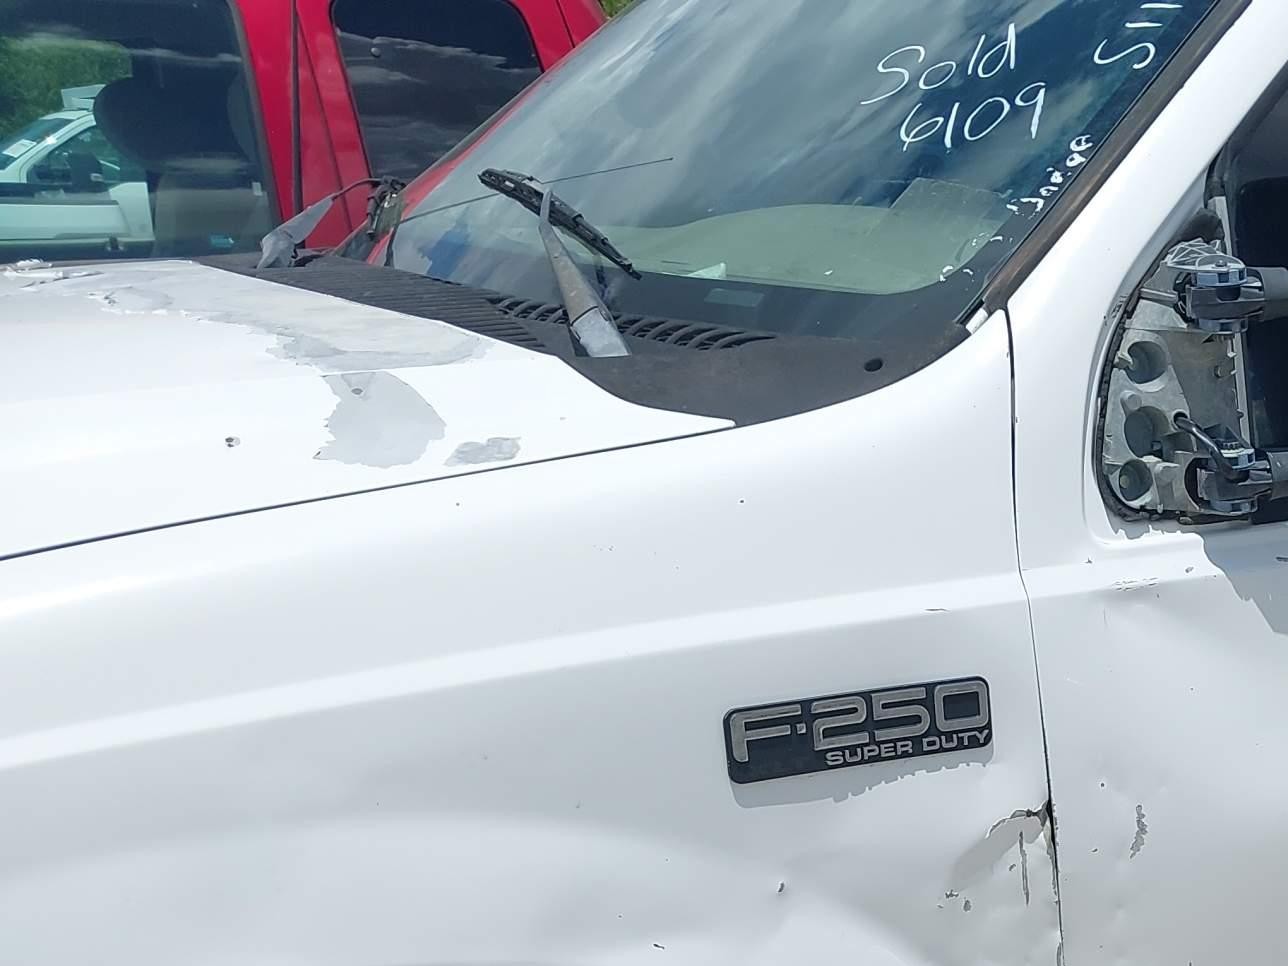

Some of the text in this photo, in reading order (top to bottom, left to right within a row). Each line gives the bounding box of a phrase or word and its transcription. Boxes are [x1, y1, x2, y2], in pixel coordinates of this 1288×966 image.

[860, 22, 1016, 105] Sold
[900, 82, 1046, 152] 6109
[824, 729, 990, 767] SUPER DUTY
